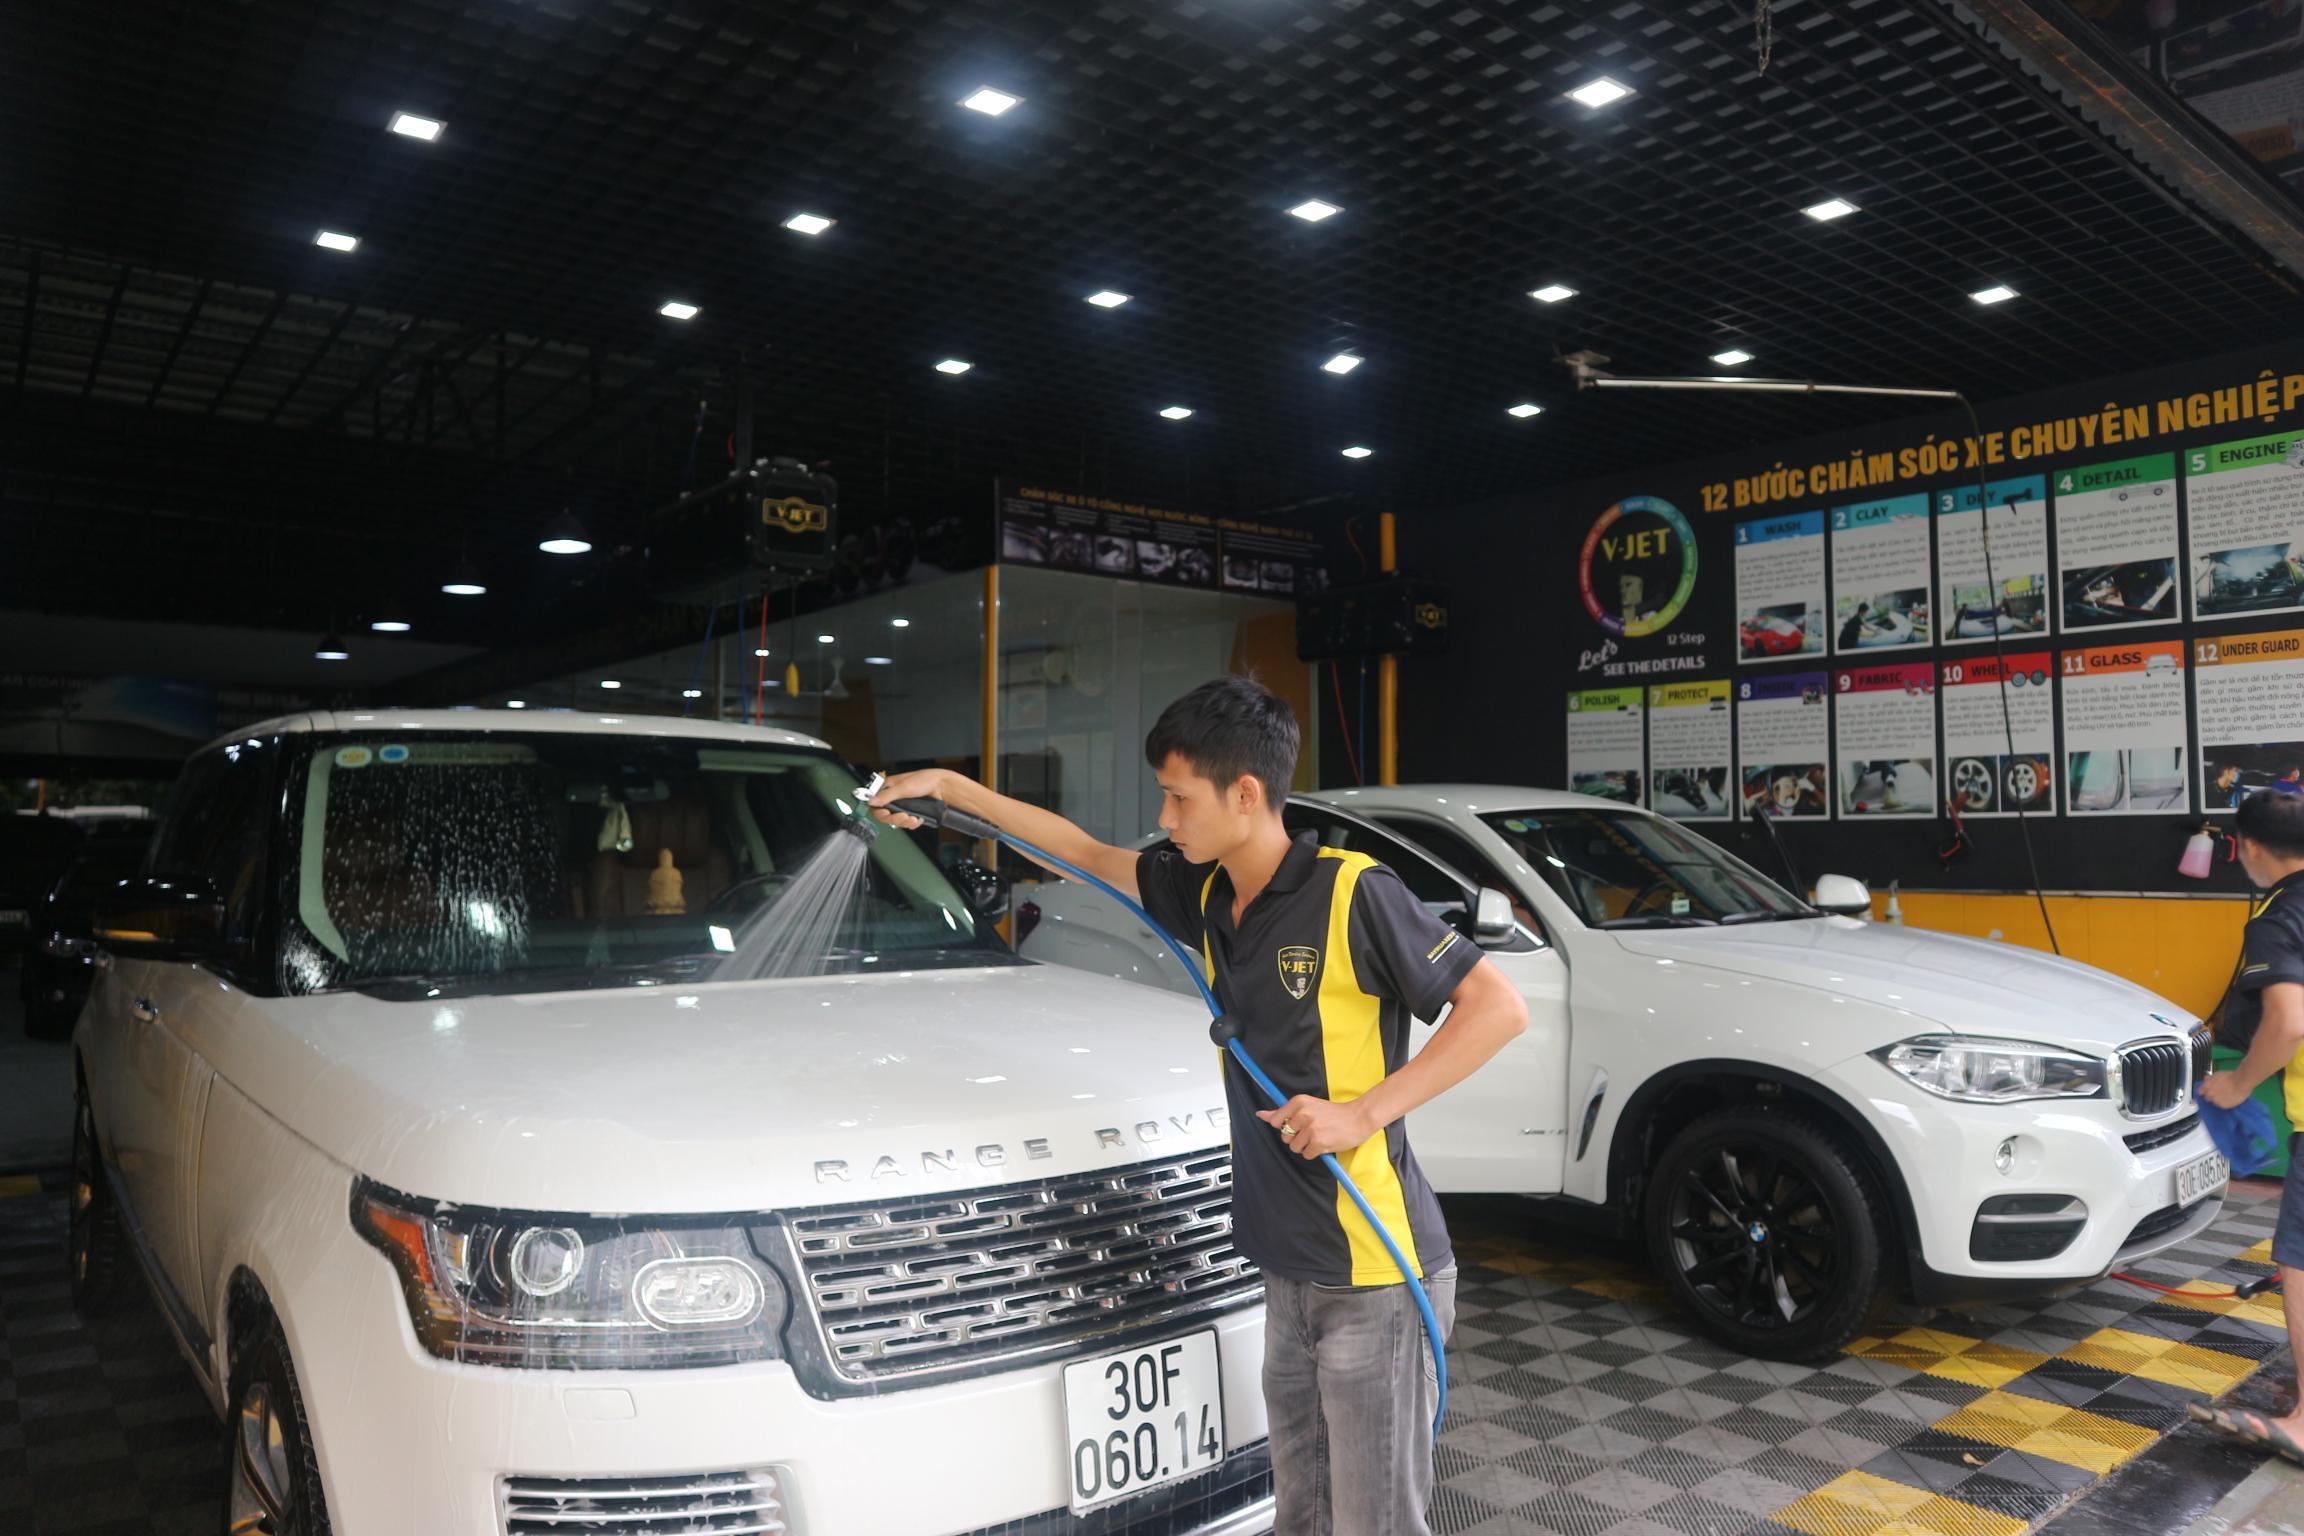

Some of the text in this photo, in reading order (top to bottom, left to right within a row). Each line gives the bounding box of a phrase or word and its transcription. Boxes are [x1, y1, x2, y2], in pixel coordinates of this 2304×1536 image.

[1700, 369, 2304, 512] 12 BƯỚC CHĂM SÓC XE CHUYÊN NGHIỆP
[2192, 441, 2286, 472] 5 ENGINE
[2059, 468, 2141, 492] 4 DETAIL
[1941, 495, 1952, 512] 3
[1836, 506, 1889, 529] 2 CLAY
[1738, 520, 1801, 544] 1 WASH
[1601, 527, 1672, 563] V-JET
[1680, 632, 1706, 647] Step
[2197, 638, 2300, 663] 12 UNDER GUARD
[1604, 655, 1706, 677] SEE THE DETAILS
[1941, 664, 1963, 684] 10
[2064, 651, 2141, 674] 11 GLASS
[1740, 682, 1751, 699] 8
[1839, 671, 1903, 692] 9 FABRIC
[1569, 693, 1620, 711] 6 POLISH
[1651, 688, 1708, 706] 7 PROTECT
[1281, 960, 1316, 974] V-JET
[1094, 1107, 1229, 1151] ROVE
[813, 1136, 1055, 1185] RANGE
[1105, 1345, 1182, 1420] 30F
[1075, 1404, 1219, 1499] 060.14
